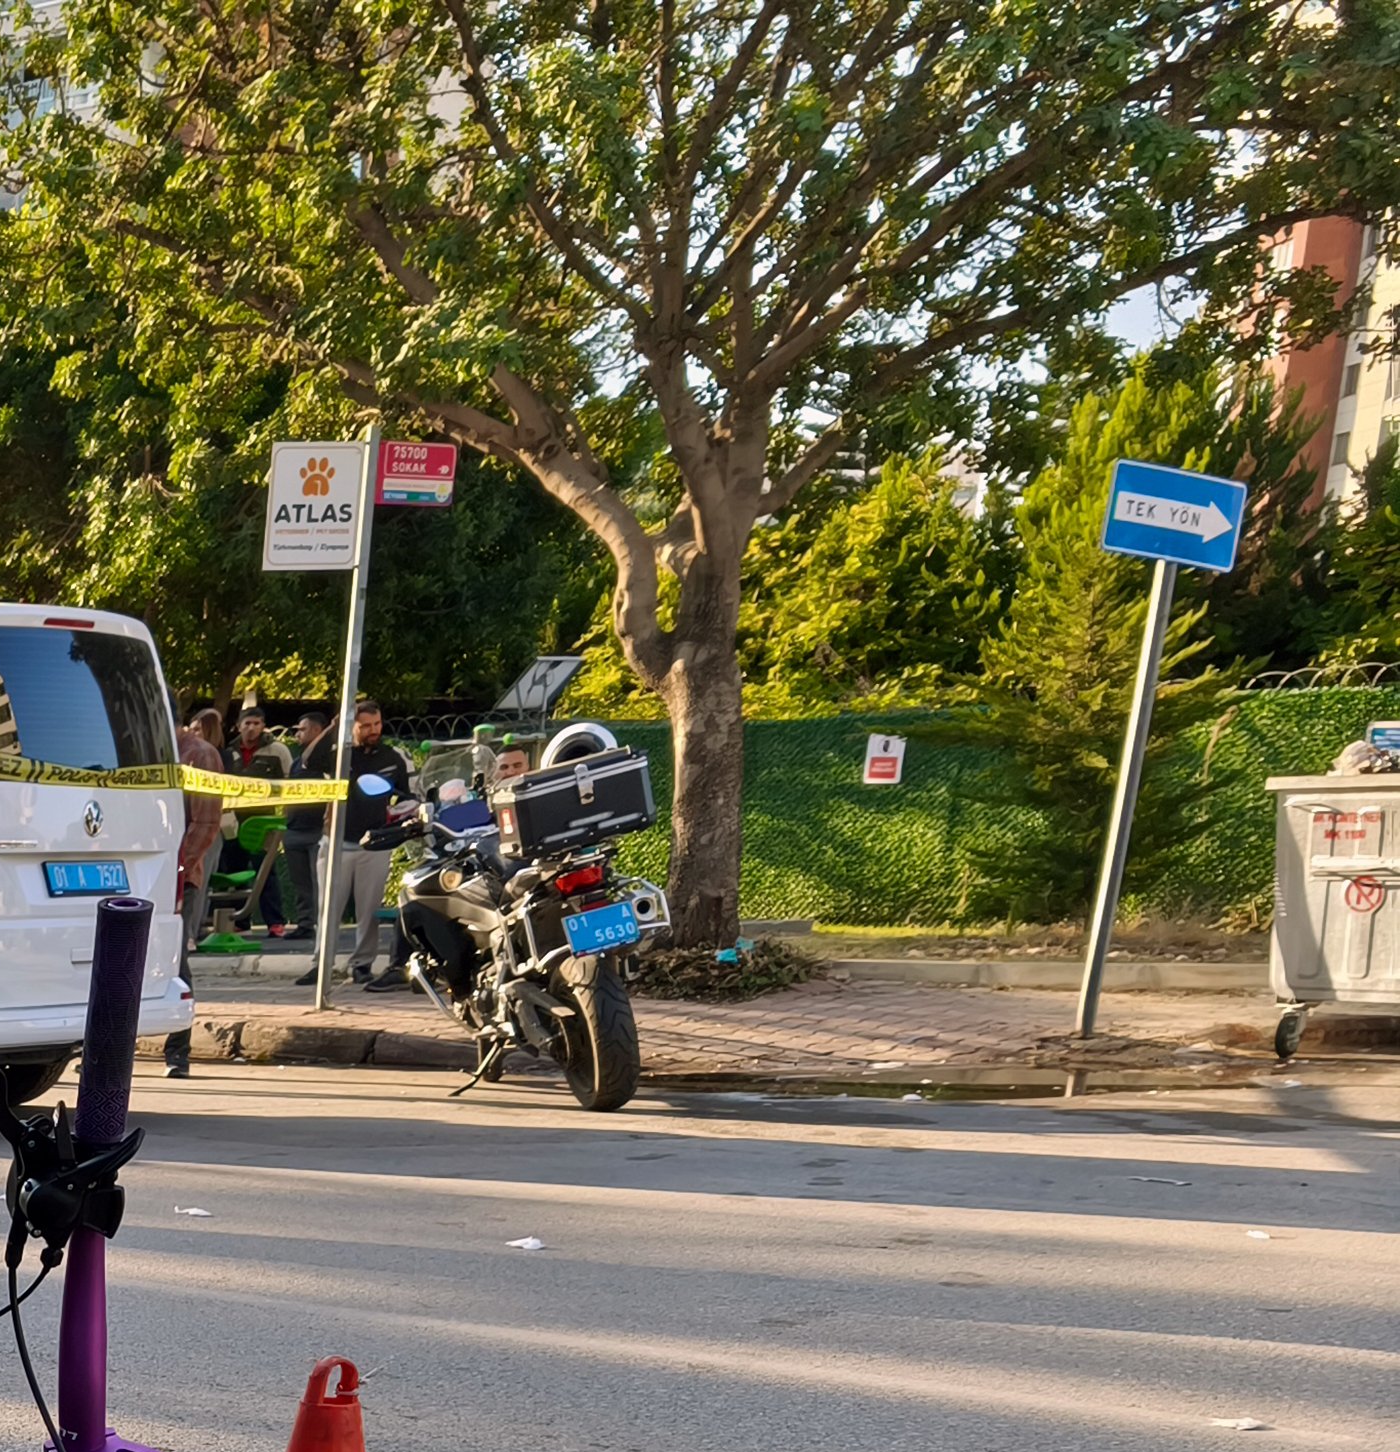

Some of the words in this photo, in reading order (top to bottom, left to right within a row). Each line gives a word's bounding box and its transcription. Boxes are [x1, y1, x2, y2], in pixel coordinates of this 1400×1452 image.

[392, 461, 427, 473] SOKAK
[274, 504, 352, 523] ATLAS
[1126, 500, 1157, 519] TEK
[1169, 506, 1201, 527] YÖN
[53, 866, 69, 887] 01
[78, 867, 86, 887] A
[96, 865, 126, 887] 7527
[568, 915, 588, 931] 01
[621, 904, 631, 918] A
[594, 921, 636, 942] 5630
